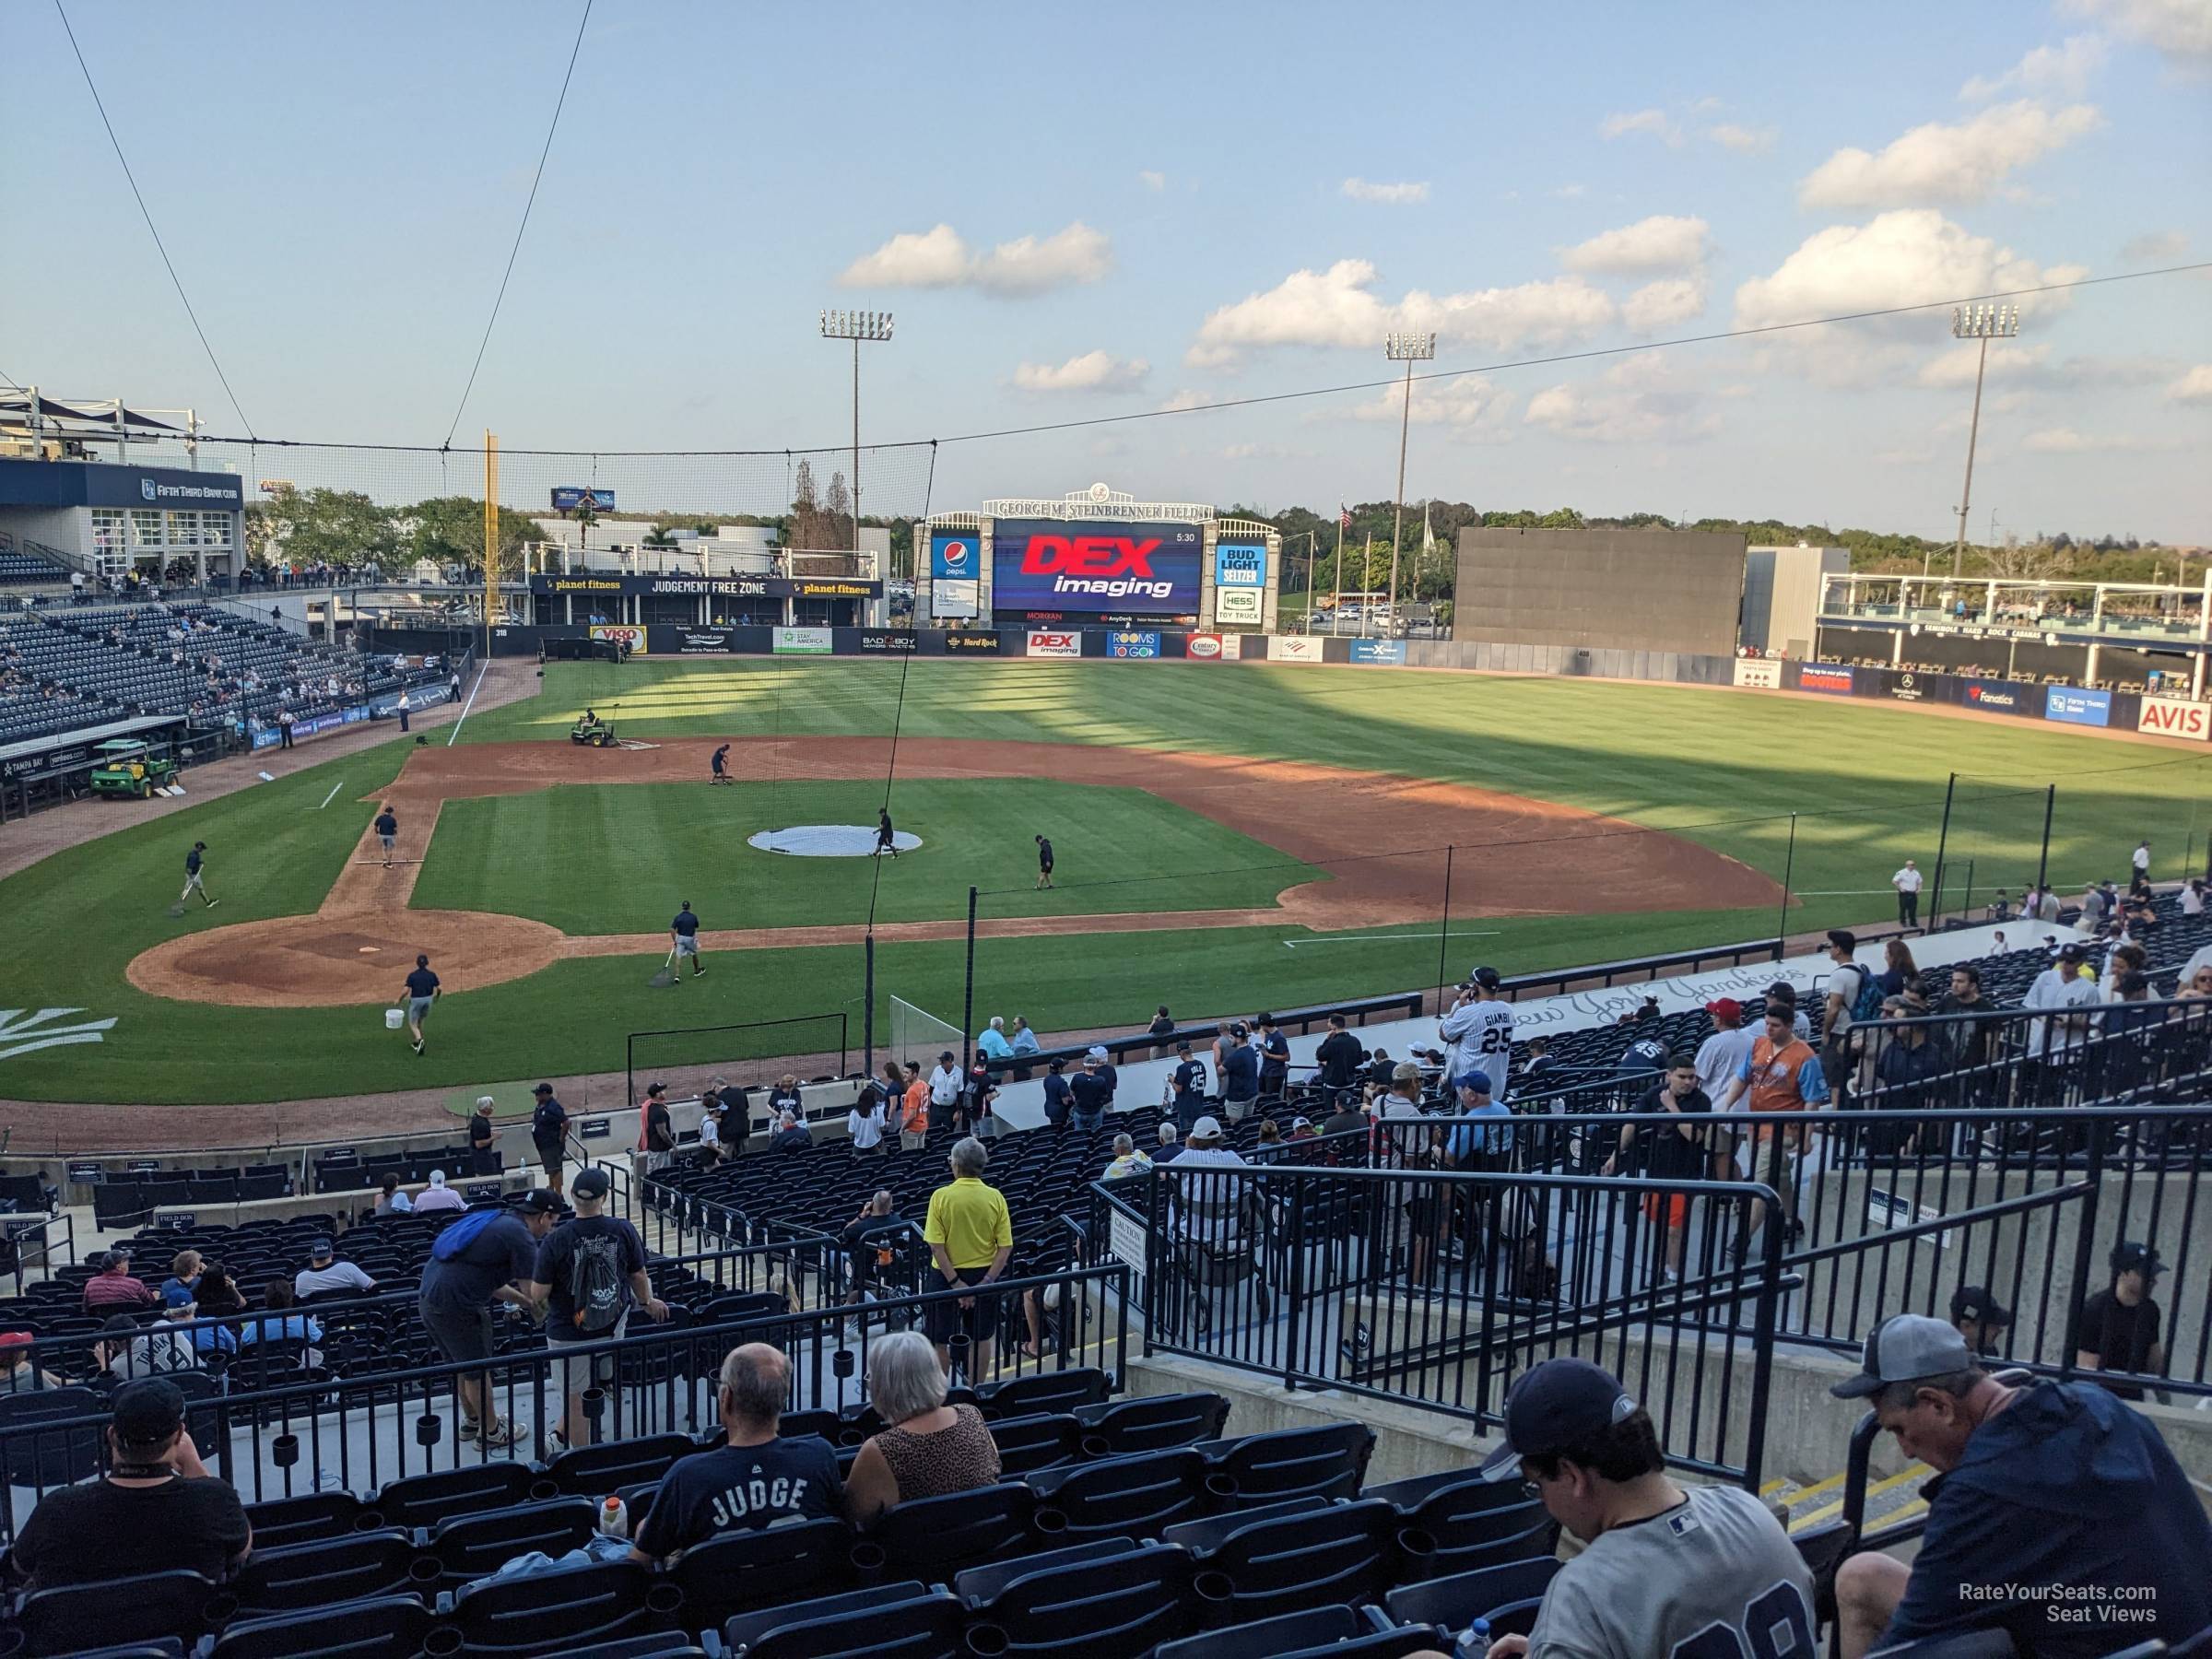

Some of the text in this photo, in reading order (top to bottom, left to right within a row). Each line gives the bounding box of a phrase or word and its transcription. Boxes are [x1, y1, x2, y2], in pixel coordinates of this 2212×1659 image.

[999, 502, 1048, 514] GEORGE
[1069, 504, 1159, 517] STEINBRENNER
[1164, 506, 1199, 518] FIELD
[1177, 534, 1194, 542] 5:30
[1020, 535, 1164, 577] DEX
[1227, 549, 1255, 559] BUD
[1221, 559, 1260, 570] LIGHT
[1223, 570, 1256, 582] SELTZER
[556, 580, 620, 590] planet fitness
[653, 582, 766, 594] JUDGEMENT FREE ZONE
[804, 583, 871, 594] planet fitness
[1053, 576, 1172, 598] imaging
[1924, 624, 1958, 633] SEMINOLE
[1962, 627, 1982, 635] HARD
[964, 638, 981, 646] Hard
[982, 639, 997, 647] Rock
[1030, 634, 1075, 647] DEX
[1113, 632, 1154, 643] ROOMS
[1113, 647, 1149, 657] TO GO
[1193, 642, 1217, 651] Century
[1980, 692, 2013, 705] Fanatics
[2086, 699, 2106, 708] THIRD
[2142, 704, 2202, 733] AVIS
[52, 751, 85, 765] yankees.com
[13, 760, 31, 772] TAMPA
[32, 758, 43, 768] BAY
[1513, 1006, 1564, 1028] ew
[1644, 968, 1806, 1005] Yankees
[1485, 1013, 1510, 1027] GIAMBI
[1481, 1026, 1512, 1054] 25
[1190, 1074, 1205, 1091] 45
[1873, 1196, 1907, 1214] STANING
[1114, 1217, 1141, 1241] CAUTION
[135, 1333, 172, 1365] TAAK
[712, 1477, 807, 1527] JUDGE
